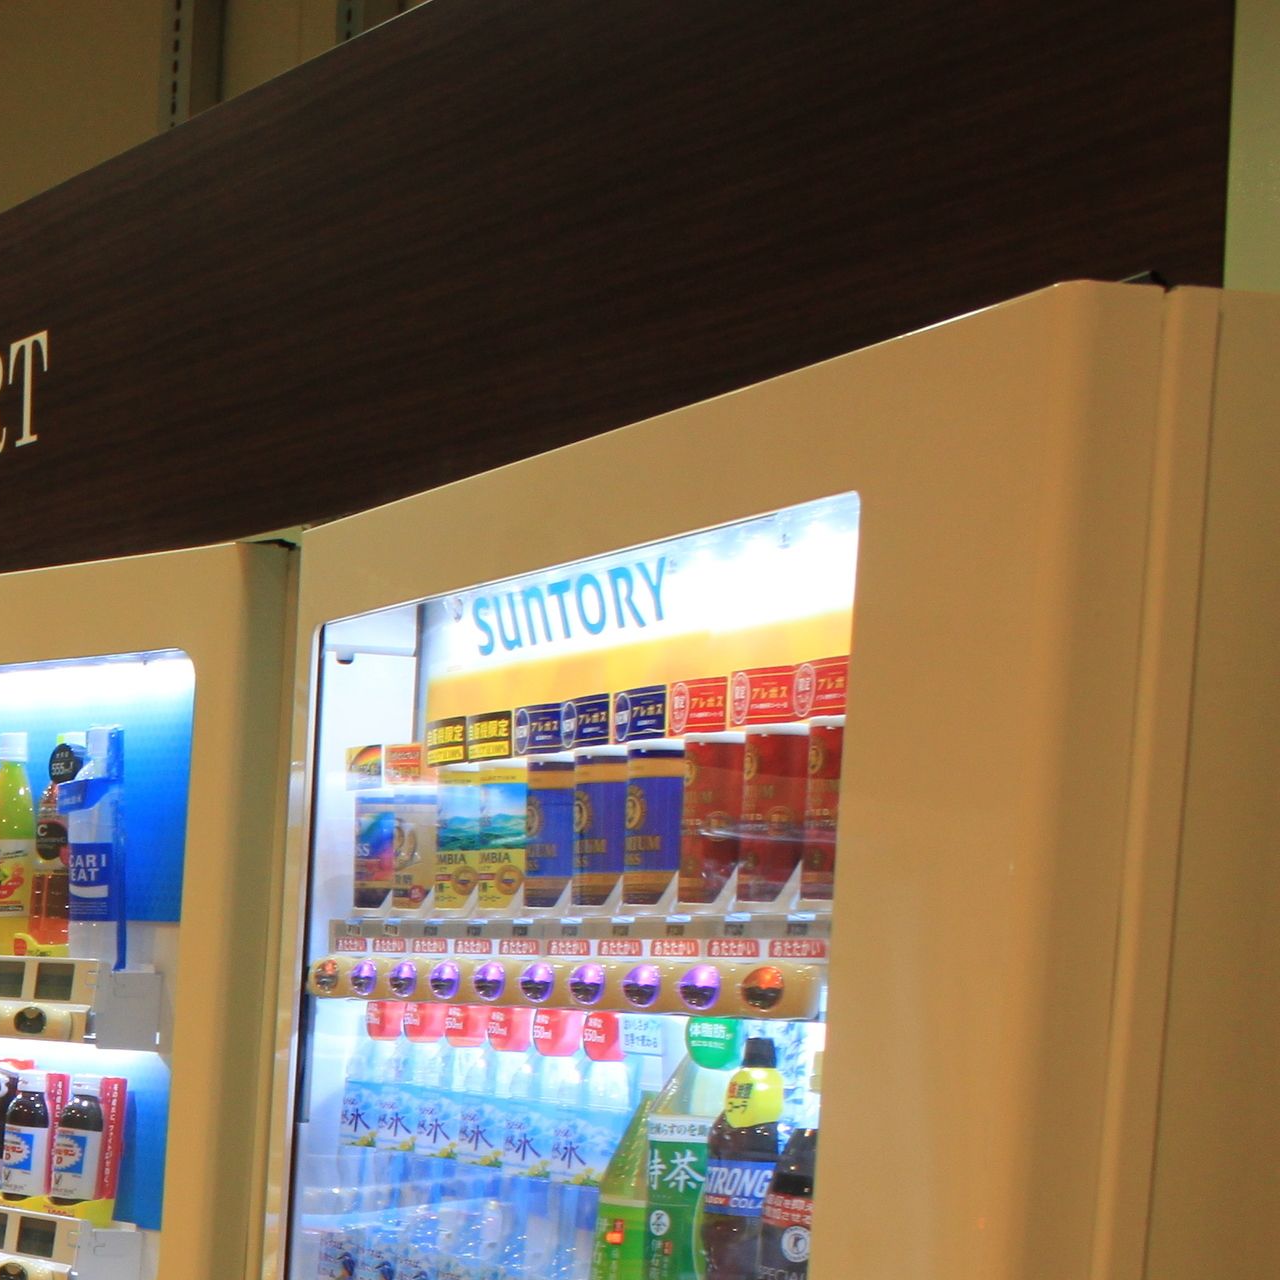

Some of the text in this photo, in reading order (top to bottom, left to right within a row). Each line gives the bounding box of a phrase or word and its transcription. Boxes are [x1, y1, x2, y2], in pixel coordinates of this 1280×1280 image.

[472, 557, 668, 657] SUNTORY
[818, 676, 845, 690] プレボ
[70, 867, 100, 882] EAT
[584, 1031, 605, 1043] 550ml
